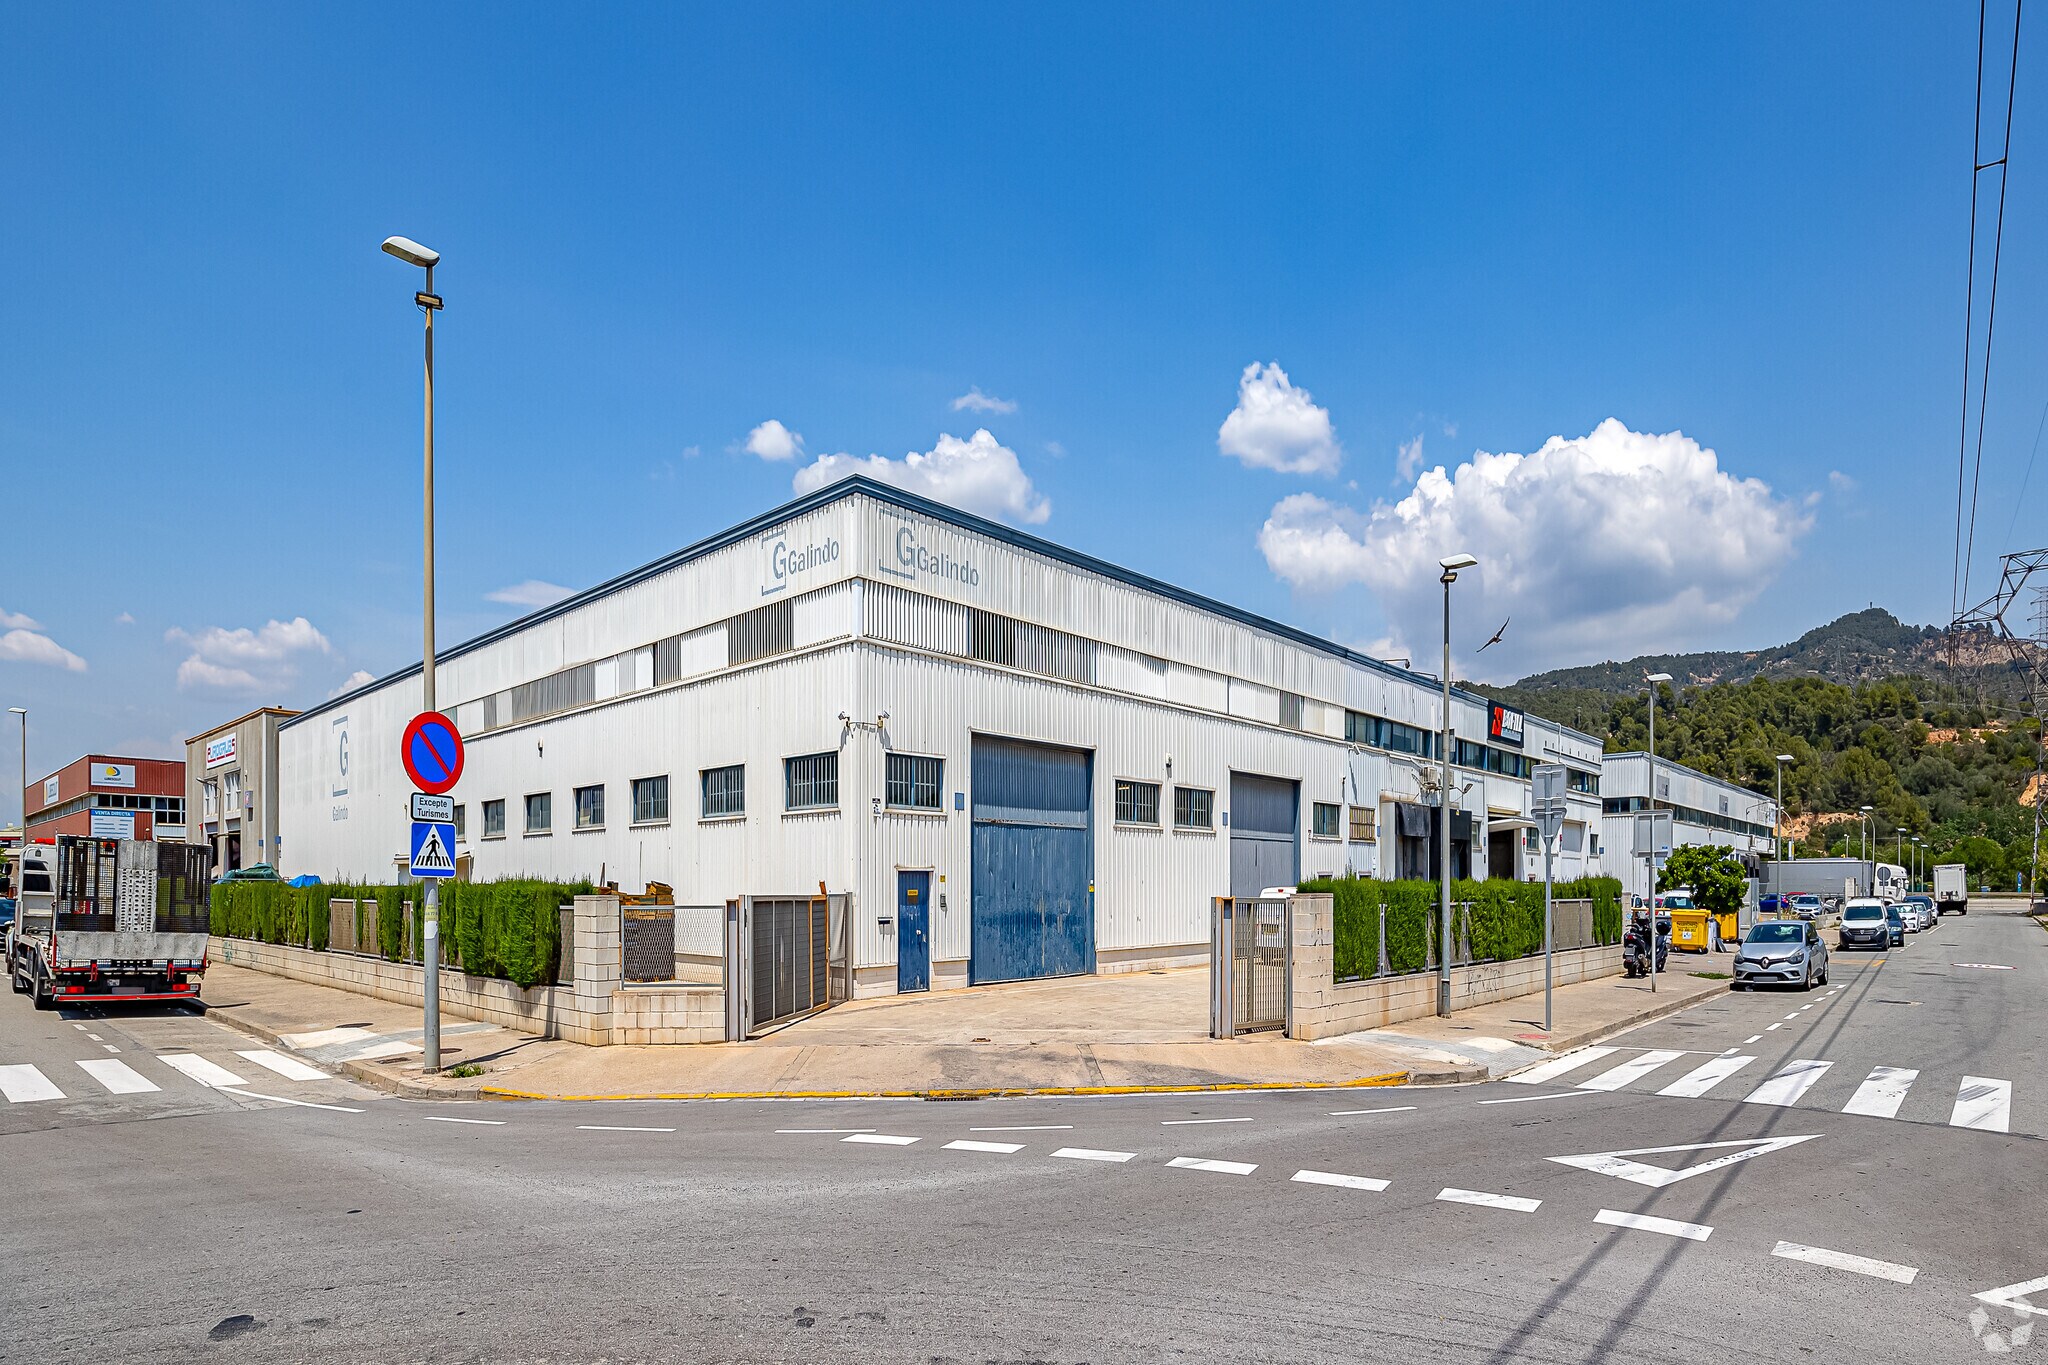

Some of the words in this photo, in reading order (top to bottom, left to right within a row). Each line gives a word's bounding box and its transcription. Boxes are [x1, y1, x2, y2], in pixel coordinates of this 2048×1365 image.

[788, 537, 840, 575] Galindo
[917, 545, 979, 587] Galindo
[417, 807, 449, 819] Turismes
[419, 797, 448, 808] Excepte
